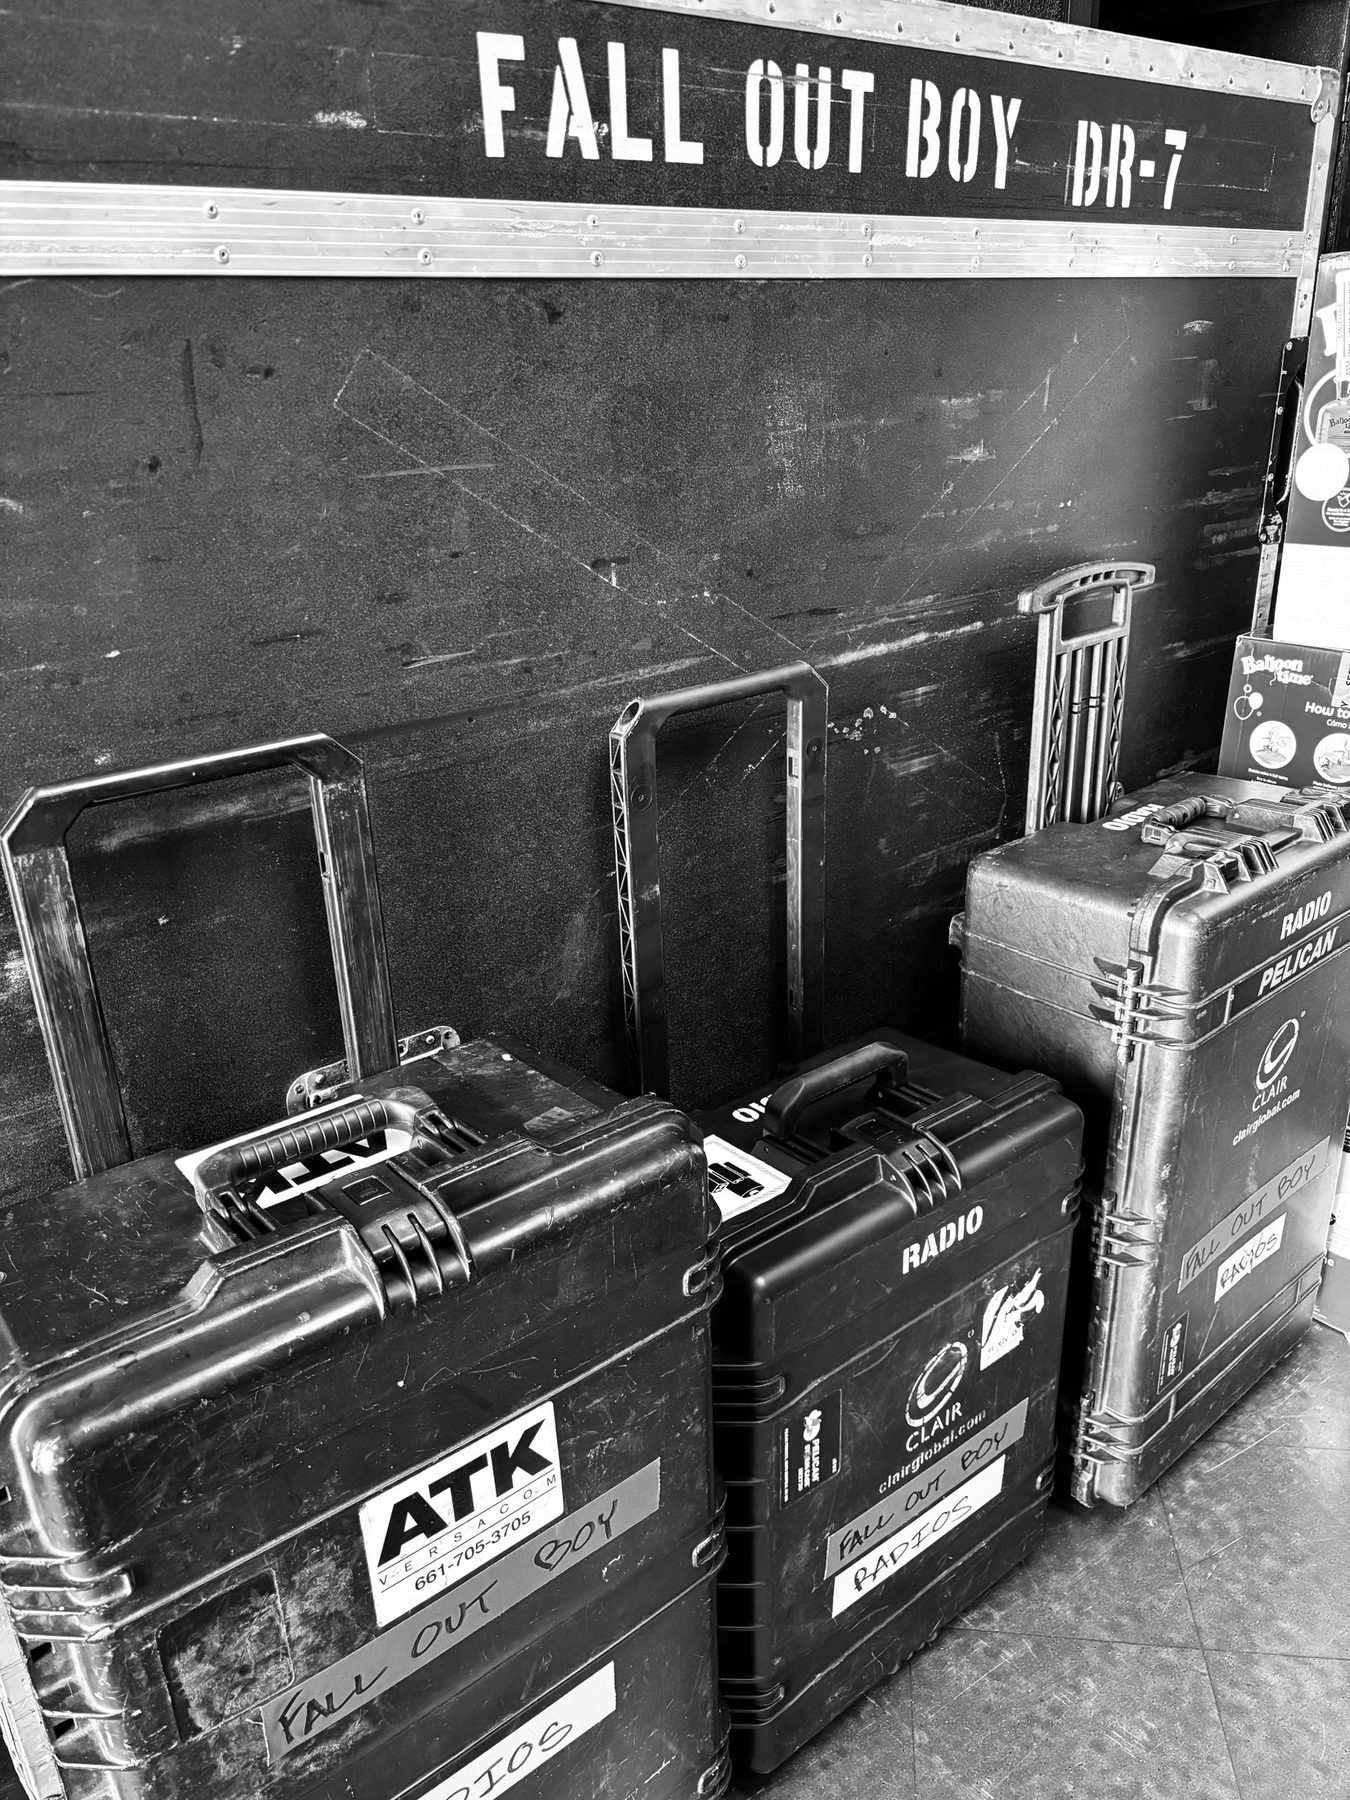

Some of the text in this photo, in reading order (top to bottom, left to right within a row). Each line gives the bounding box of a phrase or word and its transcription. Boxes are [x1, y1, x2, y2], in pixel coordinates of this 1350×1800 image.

[476, 31, 1187, 209] FALL OUT BOY DR-7
[1241, 654, 1303, 675] Balloon
[1277, 670, 1312, 685] time
[1305, 701, 1350, 719] How to
[1326, 719, 1348, 728] Cómo
[1280, 891, 1332, 940] RADIO
[1257, 926, 1339, 996] PELICAN
[1232, 1089, 1301, 1146] clairglobal.com
[1252, 1076, 1288, 1112] CLAIR
[902, 1205, 983, 1275] RADIO
[1186, 1155, 1316, 1280] FALL OUT BOY
[878, 1409, 986, 1494] clairglobal.com
[905, 1401, 963, 1453] CLAIR
[377, 1419, 554, 1568] ATK
[838, 1423, 1009, 1561] FALL OUT BOY
[414, 1510, 532, 1591] 661-705-3705
[853, 1496, 972, 1591] RADIOS
[278, 1500, 619, 1743] FALL OUT BOY
